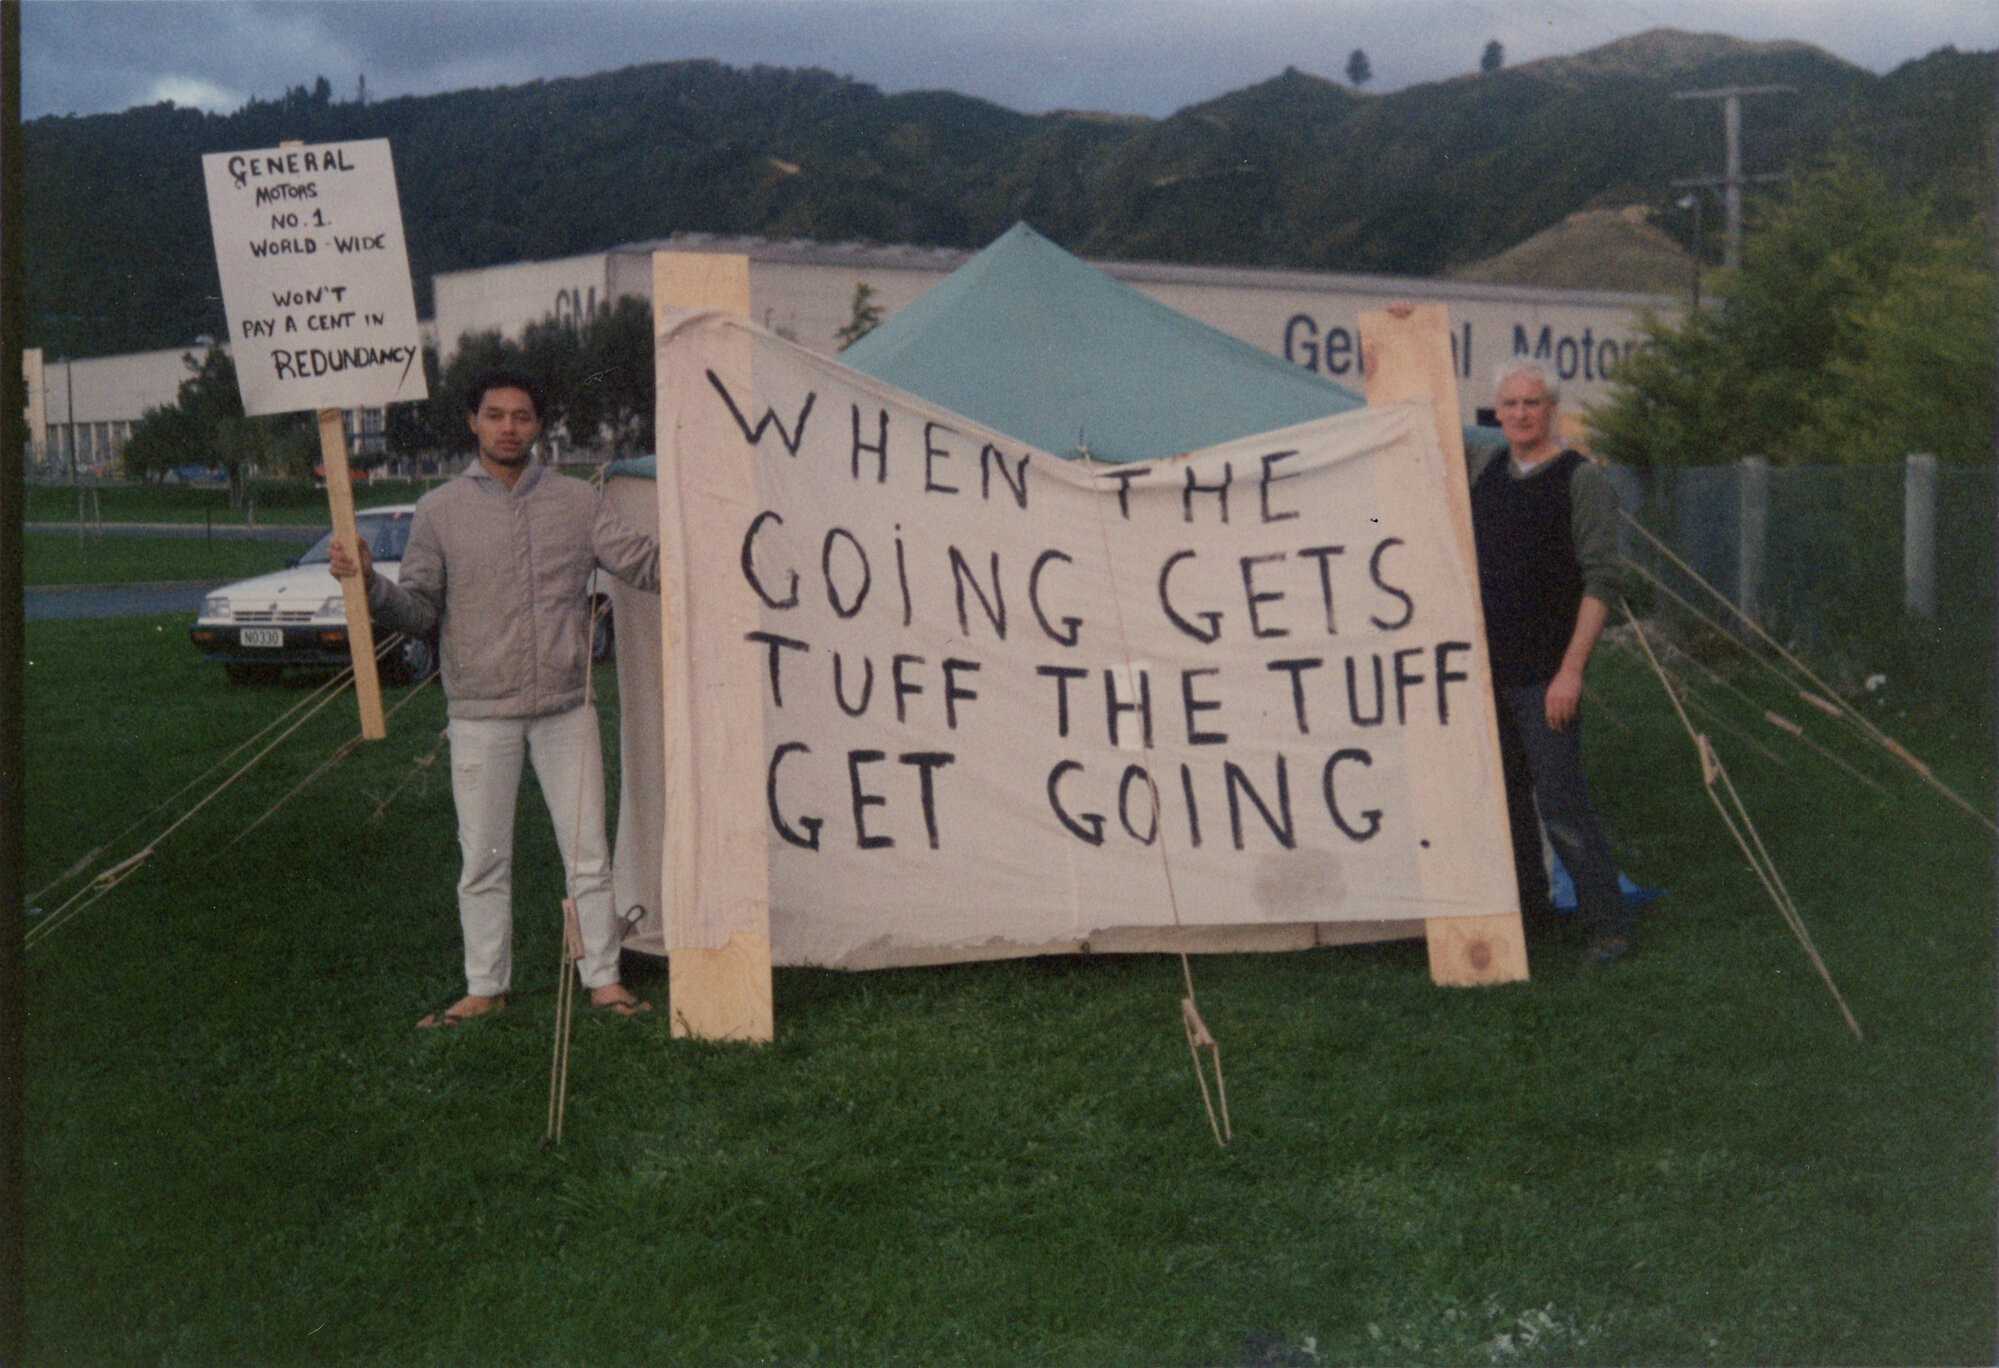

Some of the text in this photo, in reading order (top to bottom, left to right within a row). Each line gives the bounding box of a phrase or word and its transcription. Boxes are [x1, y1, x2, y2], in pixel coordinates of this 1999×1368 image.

[228, 150, 355, 189] GENERAL
[256, 182, 318, 207] MOTORS
[273, 286, 347, 307] WON'T
[242, 312, 385, 339] PAY A CENT IN
[1512, 323, 1641, 381] Motor
[271, 345, 417, 396] REDUNDANCY
[705, 368, 1301, 524] WHEN THE
[1158, 537, 1416, 645] GETS
[743, 630, 1472, 749] TUFF THE TUFF
[766, 741, 956, 851] GET
